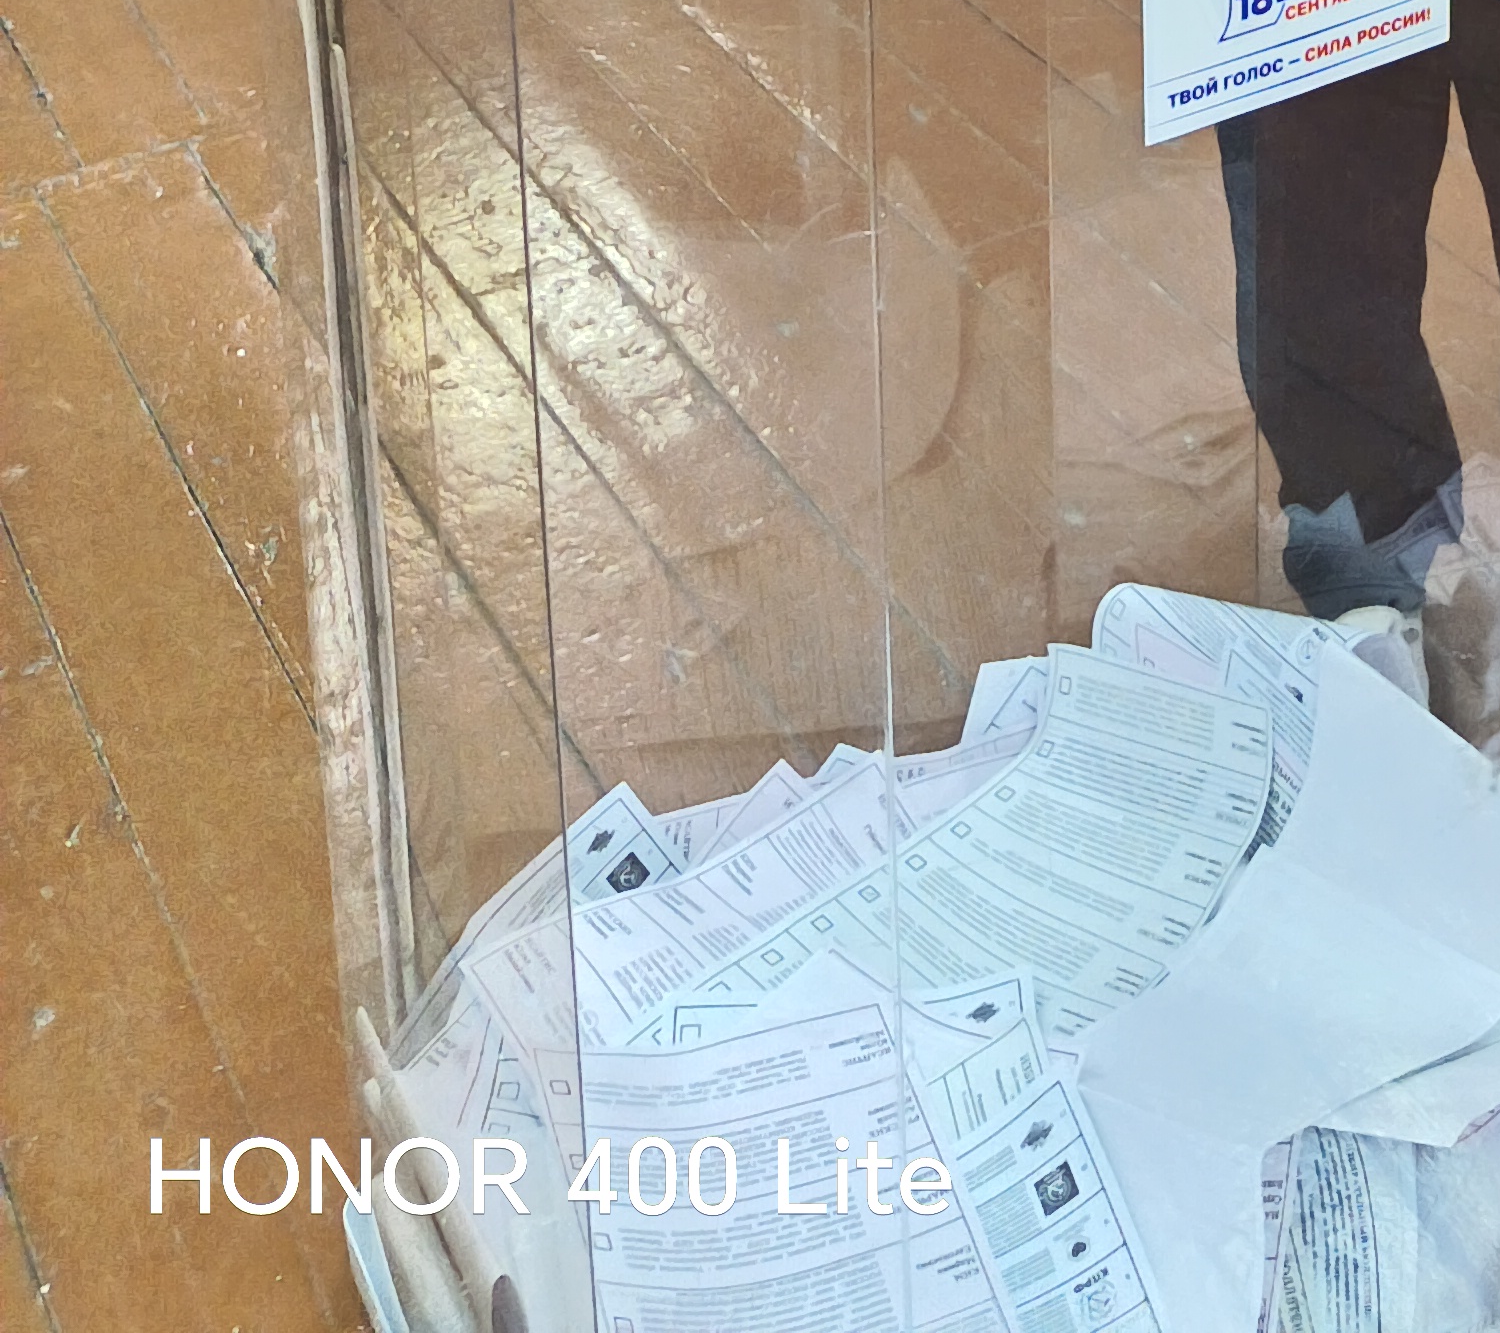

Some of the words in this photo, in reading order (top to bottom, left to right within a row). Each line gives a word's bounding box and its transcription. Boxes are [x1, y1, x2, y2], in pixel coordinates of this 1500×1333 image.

[1167, 76, 1218, 109] ТВОЙ
[1223, 57, 1284, 91] ГОЛОС
[1304, 36, 1352, 63] СИЛА
[1356, 7, 1432, 45] РОССИИ!
